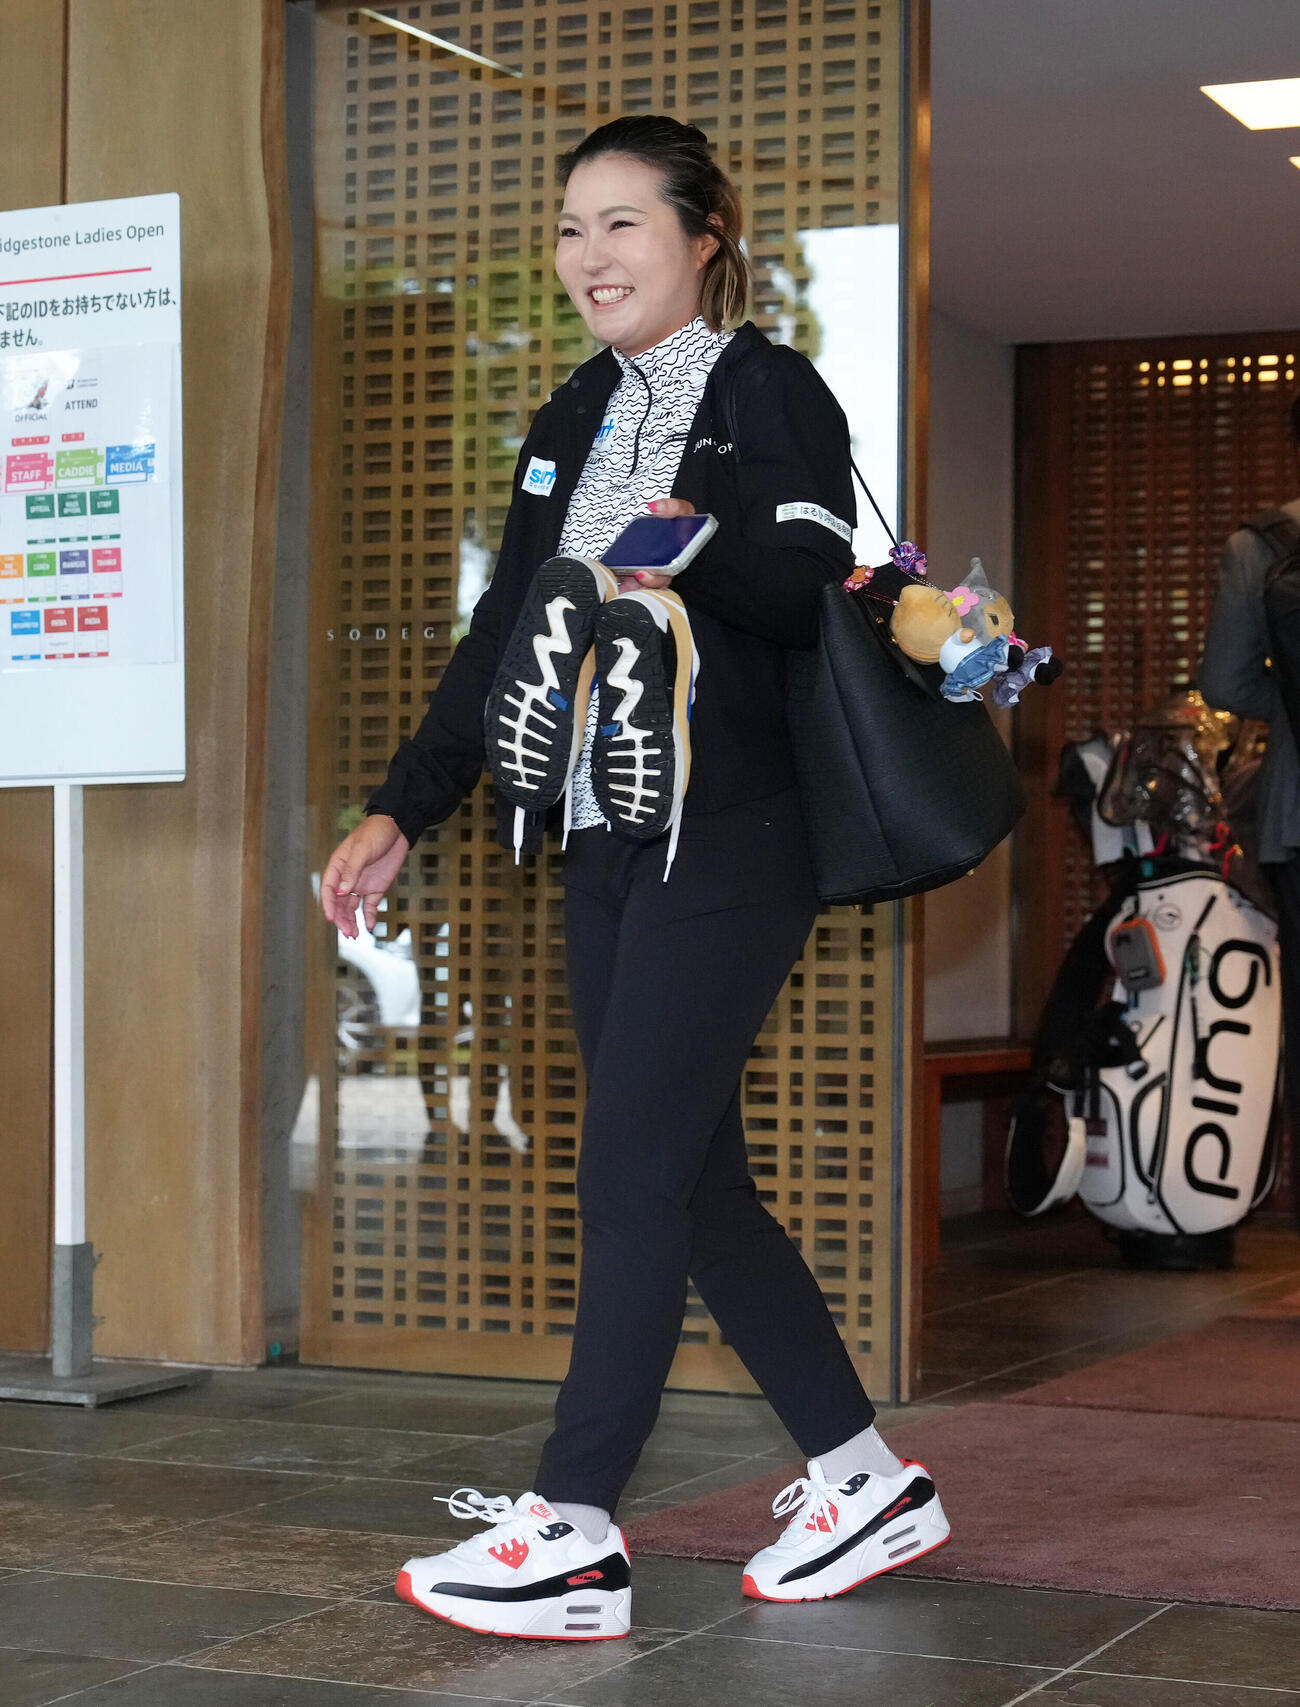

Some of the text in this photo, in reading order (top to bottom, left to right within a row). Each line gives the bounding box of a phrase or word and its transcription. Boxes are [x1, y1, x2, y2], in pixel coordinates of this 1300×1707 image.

[76, 227, 122, 245] Ladies
[126, 224, 164, 242] Open
[65, 399, 98, 411] ATTEND
[15, 413, 48, 423] OFFICIAL
[58, 465, 95, 478] CADDIE
[110, 461, 144, 473] MEDIA
[11, 470, 41, 482] STAFF
[1184, 939, 1272, 1200] ping
[536, 1503, 553, 1518] NIKE
